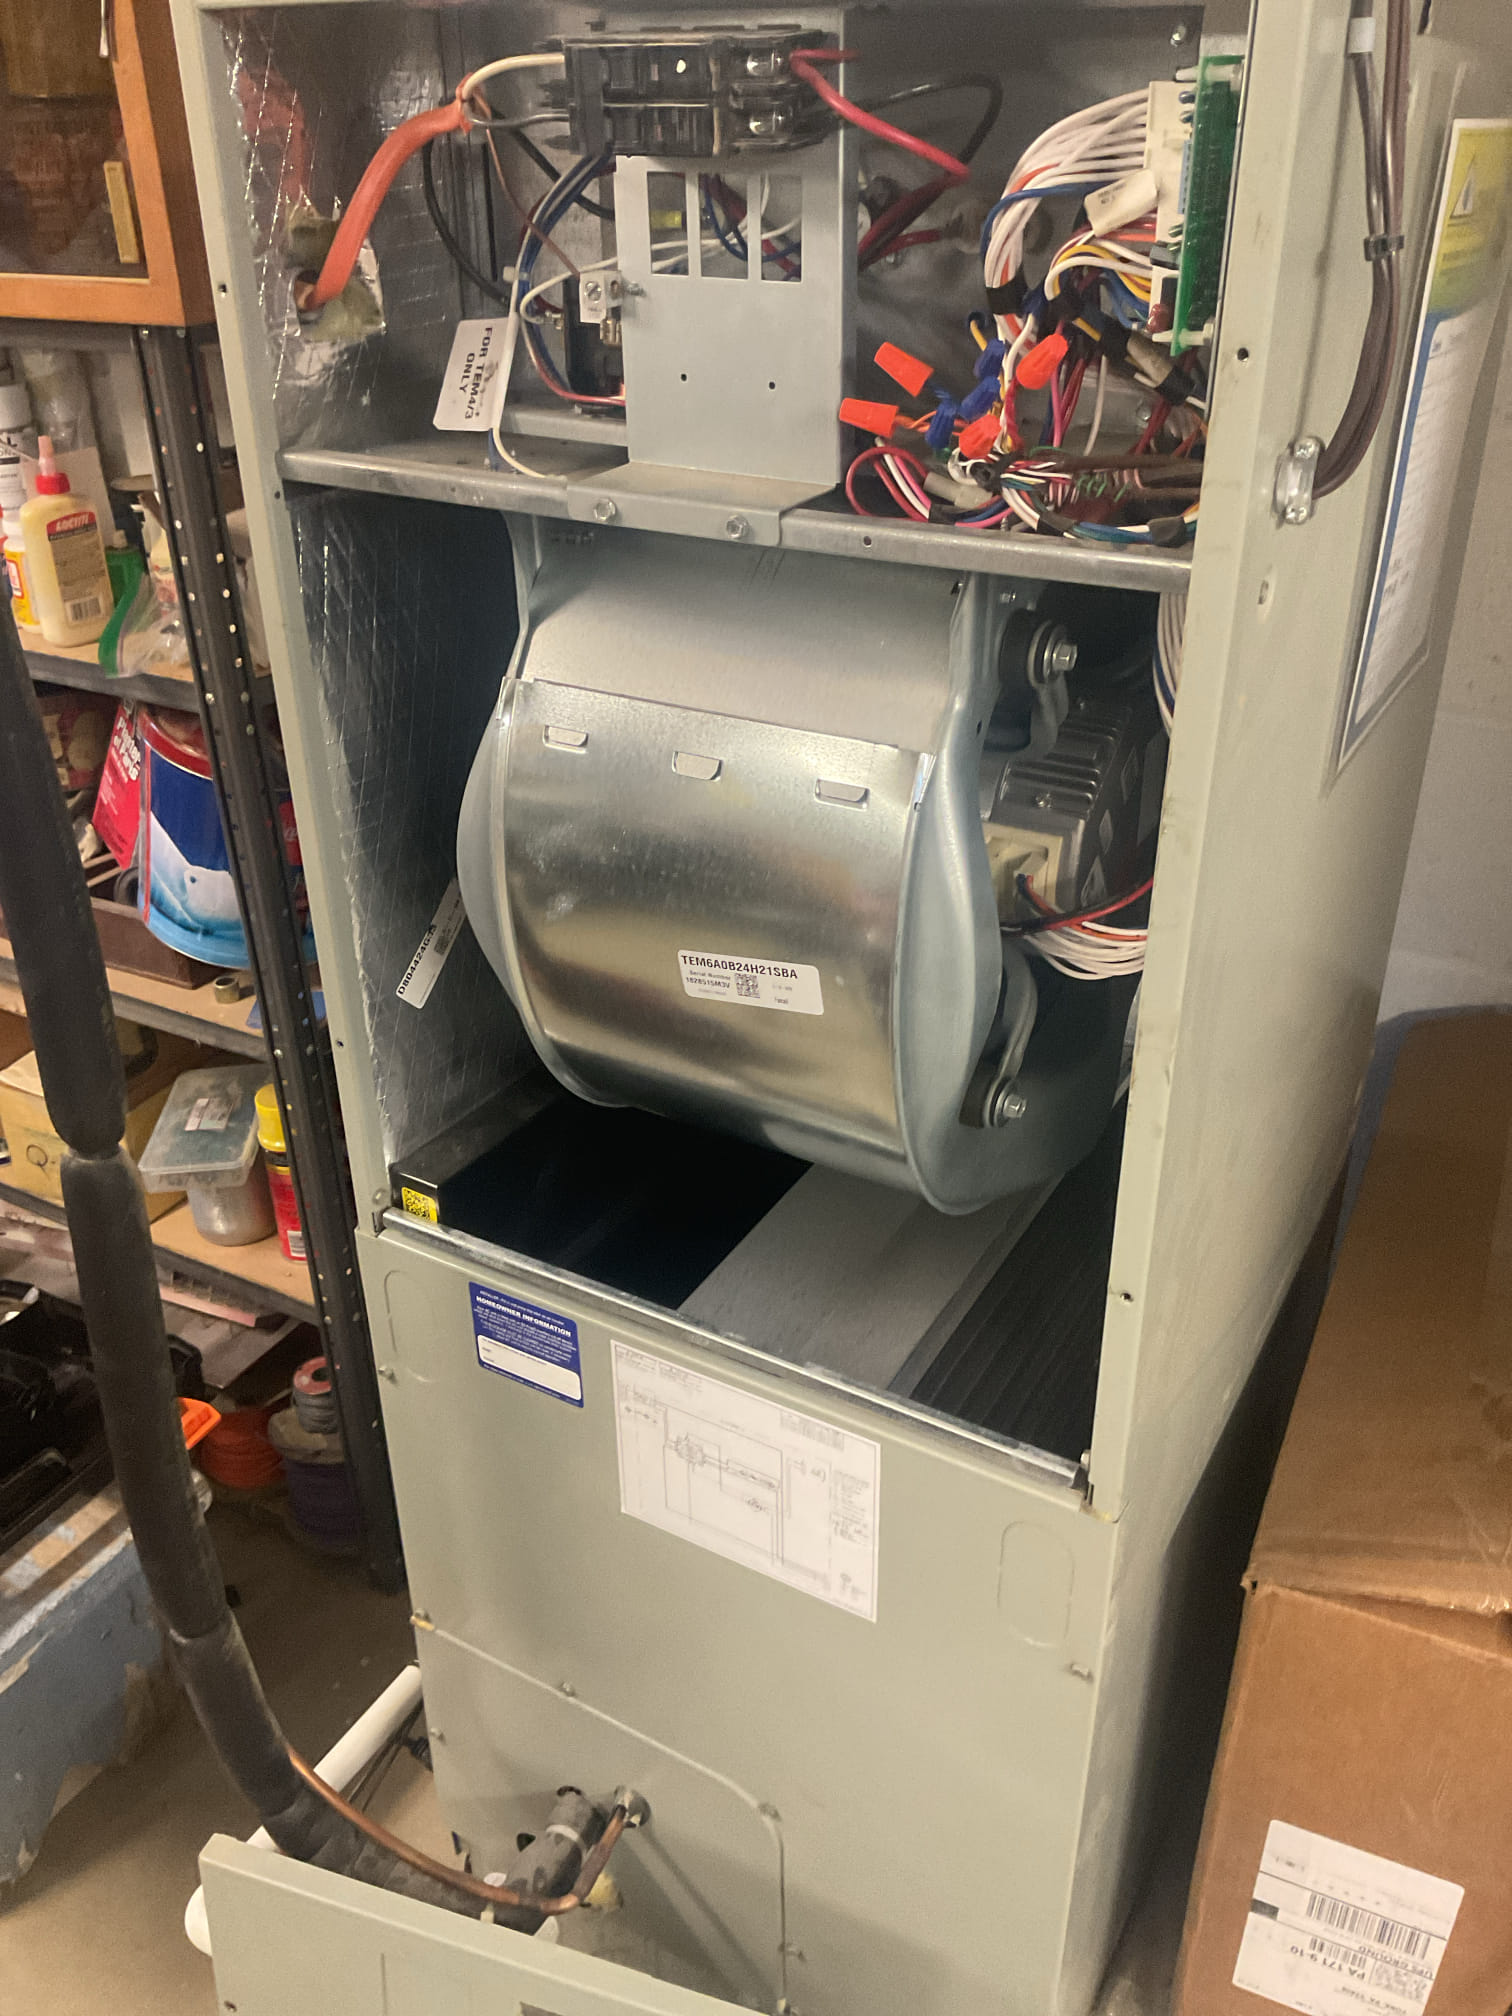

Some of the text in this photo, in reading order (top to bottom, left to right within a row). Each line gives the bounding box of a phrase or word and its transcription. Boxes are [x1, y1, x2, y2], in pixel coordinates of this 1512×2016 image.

[459, 352, 475, 392] ONLY
[464, 327, 493, 419] FOR TEM4/3
[475, 1295, 521, 1319] HOMEOWNER
[522, 1313, 572, 1337] INFORMATION
[1323, 1958, 1343, 1974] 171
[1348, 1967, 1366, 1981] PA
[1358, 1945, 1406, 1971] GROUND
